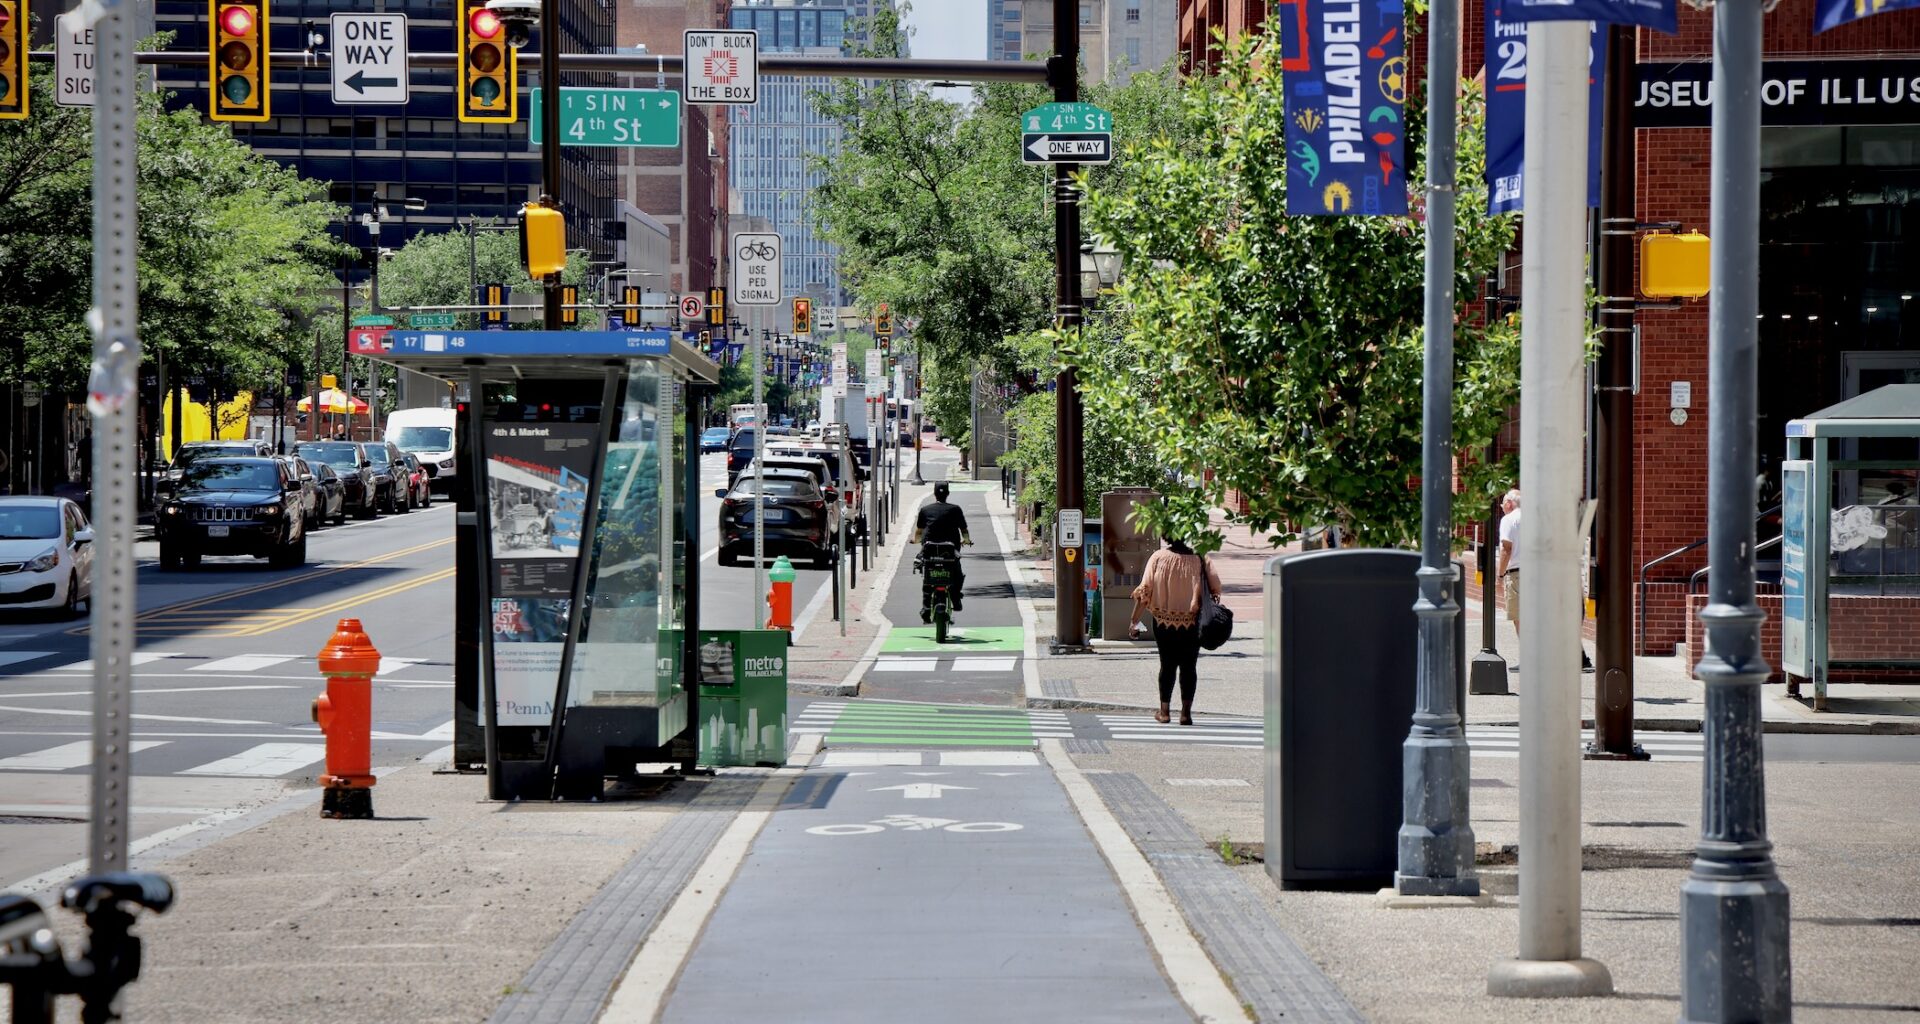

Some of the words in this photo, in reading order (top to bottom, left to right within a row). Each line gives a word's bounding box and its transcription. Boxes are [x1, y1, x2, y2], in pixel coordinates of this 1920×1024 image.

[74, 29, 94, 45] LE
[345, 21, 393, 40] ONE
[690, 36, 715, 48] DON'T
[723, 36, 752, 48] BLOCK
[73, 53, 94, 70] TU
[345, 46, 393, 64] WAY
[64, 77, 94, 94] SIG
[1323, 0, 1366, 163] PHILADEL
[691, 86, 716, 98] THE
[725, 86, 751, 99] BOX
[1761, 79, 1806, 105] OF
[566, 96, 573, 109] 1
[639, 97, 645, 110] 1
[1051, 114, 1077, 130] 4th
[1084, 113, 1106, 130] St
[569, 117, 605, 140] 4th
[613, 118, 642, 142] St
[1049, 142, 1072, 153] ONE
[1077, 142, 1100, 153] WAY
[748, 265, 766, 275] USE
[748, 277, 766, 287] PED
[741, 290, 775, 299] SIGNAL
[416, 315, 434, 325] 5th
[438, 316, 449, 324] St
[403, 336, 418, 347] 17
[450, 337, 465, 348] 48
[492, 428, 508, 436] 4th
[509, 428, 517, 436] &
[518, 428, 550, 436] Market
[492, 601, 521, 612] HEN.
[493, 624, 518, 634] OW.
[744, 656, 784, 671] metro
[506, 700, 541, 715] Penn
